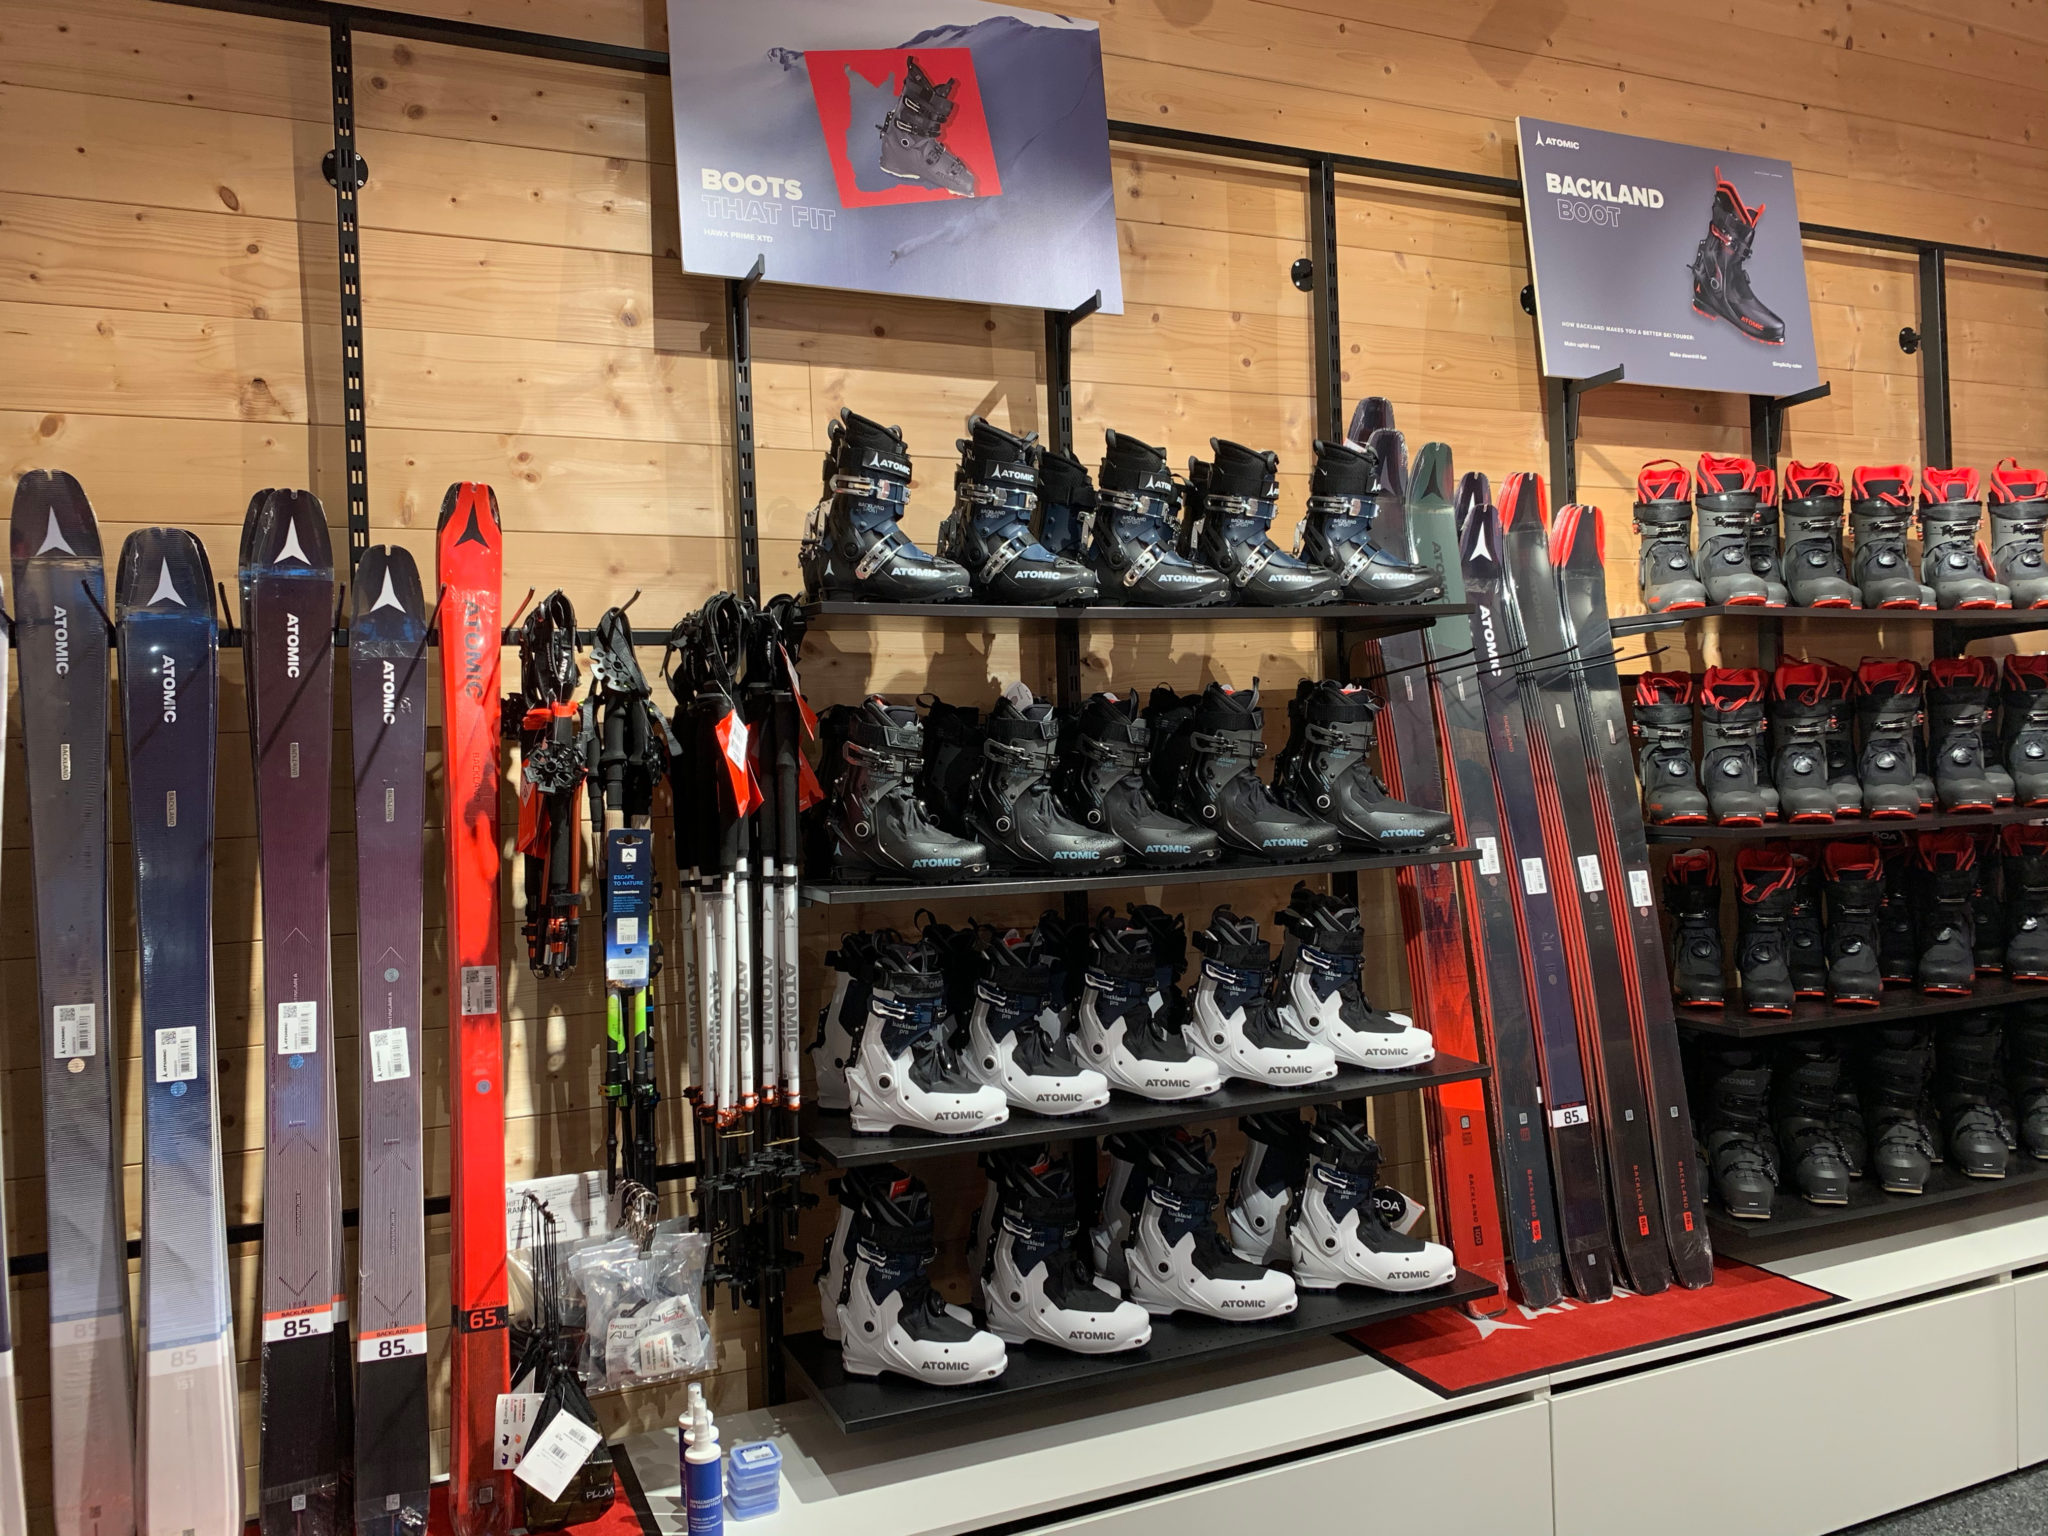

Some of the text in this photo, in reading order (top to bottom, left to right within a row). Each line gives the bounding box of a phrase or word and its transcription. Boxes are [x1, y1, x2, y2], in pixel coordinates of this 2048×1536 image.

[1545, 137, 1579, 149] ATOMIC
[701, 168, 803, 200] BOOTS
[1546, 172, 1664, 209] BACKLAND
[702, 194, 836, 231] THAT FIT
[1557, 198, 1620, 227] BOOT
[1576, 323, 1605, 331] BACKLAND
[1741, 316, 1764, 331] ATOMIC
[880, 458, 910, 475] ATOMIC
[1001, 470, 1035, 482] ATOMIC
[891, 566, 941, 578] ATOMIC
[1015, 569, 1061, 580] ATOMIC
[1158, 574, 1204, 583] ATOMIC
[1268, 574, 1313, 583] ATOMIC
[1371, 572, 1416, 582] ATOMIC
[54, 605, 69, 675] ATOMIC
[286, 613, 300, 679] ATOMIC
[1479, 605, 1502, 677] ATOMIC
[464, 598, 483, 698] ATOMIC
[162, 655, 176, 724] ATOMIC
[382, 661, 396, 725] ATOMIC
[62, 744, 70, 779] BACKLAND
[1380, 829, 1425, 838] ATOMIC
[1145, 845, 1191, 854] ATOMIC
[1262, 838, 1309, 848] ATOMIC
[912, 857, 962, 869] ATOMIC
[1052, 851, 1100, 861] ATOMIC
[738, 960, 751, 1052] ATOMIC
[763, 955, 774, 1045] ATOMIC
[785, 961, 798, 1053] ATOMIC
[1365, 1047, 1409, 1056] ATOMIC
[1267, 1065, 1313, 1075] ATOMIC
[1145, 1078, 1191, 1088] ATOMIC
[1035, 1093, 1083, 1103] ATOMIC
[934, 1110, 984, 1122] ATOMIC
[1564, 1110, 1580, 1125] 85
[1633, 1164, 1645, 1214] BACKLAND
[1678, 1161, 1689, 1209] BACKLAND
[1527, 1168, 1538, 1218] BACKLAND
[1468, 1174, 1482, 1245] BACKLAND 100
[1386, 1270, 1430, 1280] ATOMIC
[1220, 1299, 1266, 1309] ATOMIC
[281, 1308, 315, 1318] BACKLAND
[470, 1309, 497, 1329] 65
[74, 1323, 100, 1339] 85
[283, 1318, 311, 1338] 85
[376, 1328, 409, 1338] BACKLAND
[1068, 1330, 1116, 1341] ATOMIC
[378, 1338, 406, 1358] 85
[170, 1349, 198, 1368] 85
[921, 1361, 970, 1371] ATOMIC
